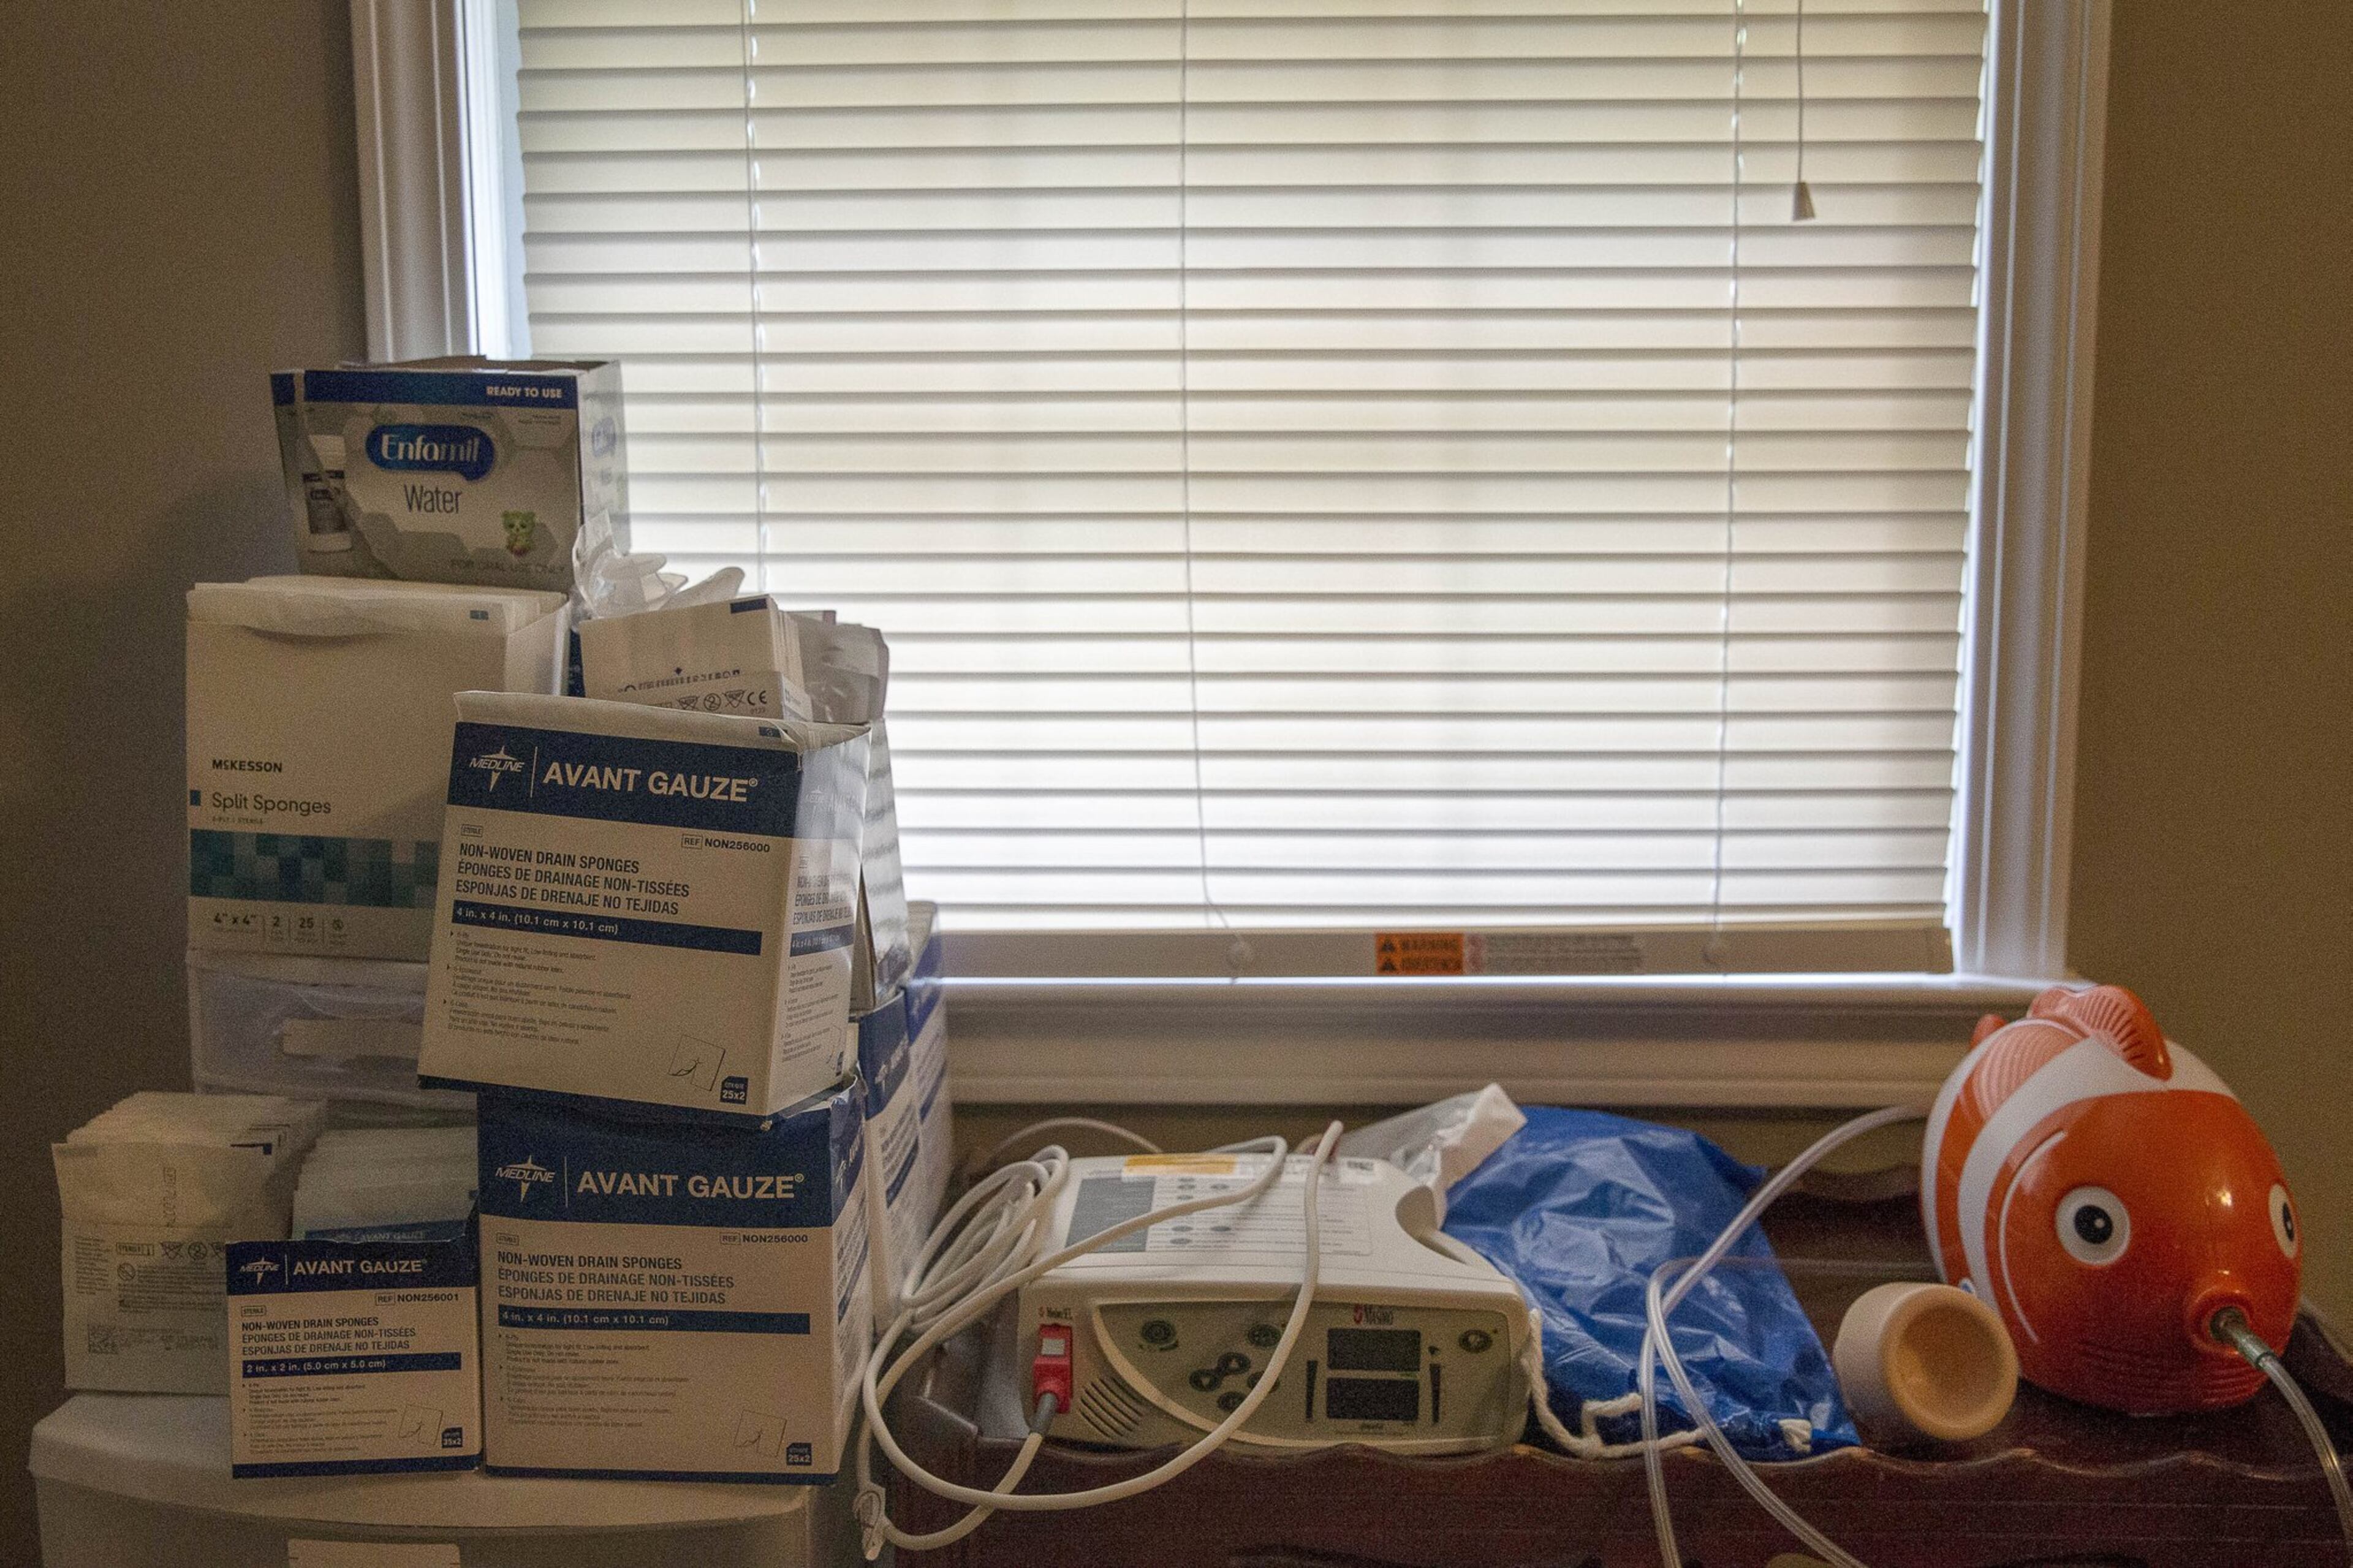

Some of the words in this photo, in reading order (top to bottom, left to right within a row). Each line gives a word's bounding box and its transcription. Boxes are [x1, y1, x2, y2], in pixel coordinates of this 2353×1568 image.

[487, 385, 521, 398] READY
[525, 387, 538, 398] TO
[542, 387, 562, 398] USE
[381, 433, 479, 463] Enfamil
[404, 484, 461, 514] Water
[469, 757, 525, 773] MEDLINE
[543, 762, 642, 793] AVANT
[212, 792, 249, 810] Split
[253, 795, 332, 816] Sponges
[684, 837, 701, 846] REF
[705, 838, 770, 853] NON256000
[460, 843, 532, 863] NON-WOVEN
[536, 852, 575, 868] DRAIN
[580, 855, 639, 874] SPONGES
[458, 859, 511, 879] ÉPONGES
[515, 868, 531, 881] DE
[534, 870, 600, 888] DRAINAGE
[604, 876, 690, 898] NON-TISSÉES
[456, 879, 517, 898] ESPONJAS
[521, 887, 537, 901] DE
[541, 890, 599, 907] DRENAJE
[603, 896, 621, 909] NO
[626, 898, 678, 915] TEJIDAS
[272, 916, 280, 927] 2
[299, 917, 314, 929] 25
[466, 910, 477, 918] in.
[490, 911, 496, 920] 4
[499, 914, 511, 923] in.
[515, 915, 539, 926] (10.1
[543, 919, 559, 928] cm
[573, 920, 594, 931] 10.1
[598, 923, 618, 935] cm)
[722, 1090, 746, 1101] 25x2
[494, 1167, 555, 1183] MEDLINE
[577, 1171, 678, 1197] AVANT
[742, 1234, 808, 1243] NON256000
[293, 1260, 355, 1276] AVANT
[498, 1251, 574, 1267] NON-WOVEN
[578, 1256, 618, 1268] DRAIN
[623, 1257, 681, 1270] SPONGES
[498, 1266, 554, 1284] ÉPONGES
[558, 1272, 575, 1284] DE
[579, 1273, 644, 1286] DRAINAGE
[648, 1273, 734, 1288] NON-TISSÉES
[397, 1293, 459, 1303] NON256001
[498, 1286, 562, 1301] ESPONJAS
[567, 1289, 583, 1301] DE
[588, 1290, 646, 1302] DRENAJE
[651, 1290, 668, 1303] NO
[673, 1291, 726, 1305] TEJIDAS
[242, 1320, 300, 1331] NON-WOVEN
[303, 1318, 332, 1328] DRAIN
[335, 1317, 379, 1327] SPONGES
[502, 1312, 509, 1320] 4
[512, 1312, 524, 1322] in.
[537, 1314, 544, 1322] 4
[547, 1314, 559, 1323] in.
[563, 1314, 588, 1324] (10.1
[624, 1315, 644, 1324] 10.1
[648, 1316, 669, 1326] cm)
[289, 1332, 300, 1341] DE
[304, 1330, 351, 1341] DRAINAGE
[354, 1327, 415, 1339] NON-TISSÉES
[243, 1344, 292, 1356] ESPONJAS
[295, 1344, 306, 1354] DE
[309, 1343, 353, 1353] DRENAJE
[355, 1342, 367, 1350] NO
[371, 1340, 409, 1350] TEJIDAS
[246, 1365, 253, 1373] 2
[289, 1362, 300, 1371] in.
[303, 1361, 321, 1372] (5.0
[324, 1362, 338, 1370] cm
[350, 1360, 365, 1369] 5.0
[368, 1360, 386, 1369] cm)
